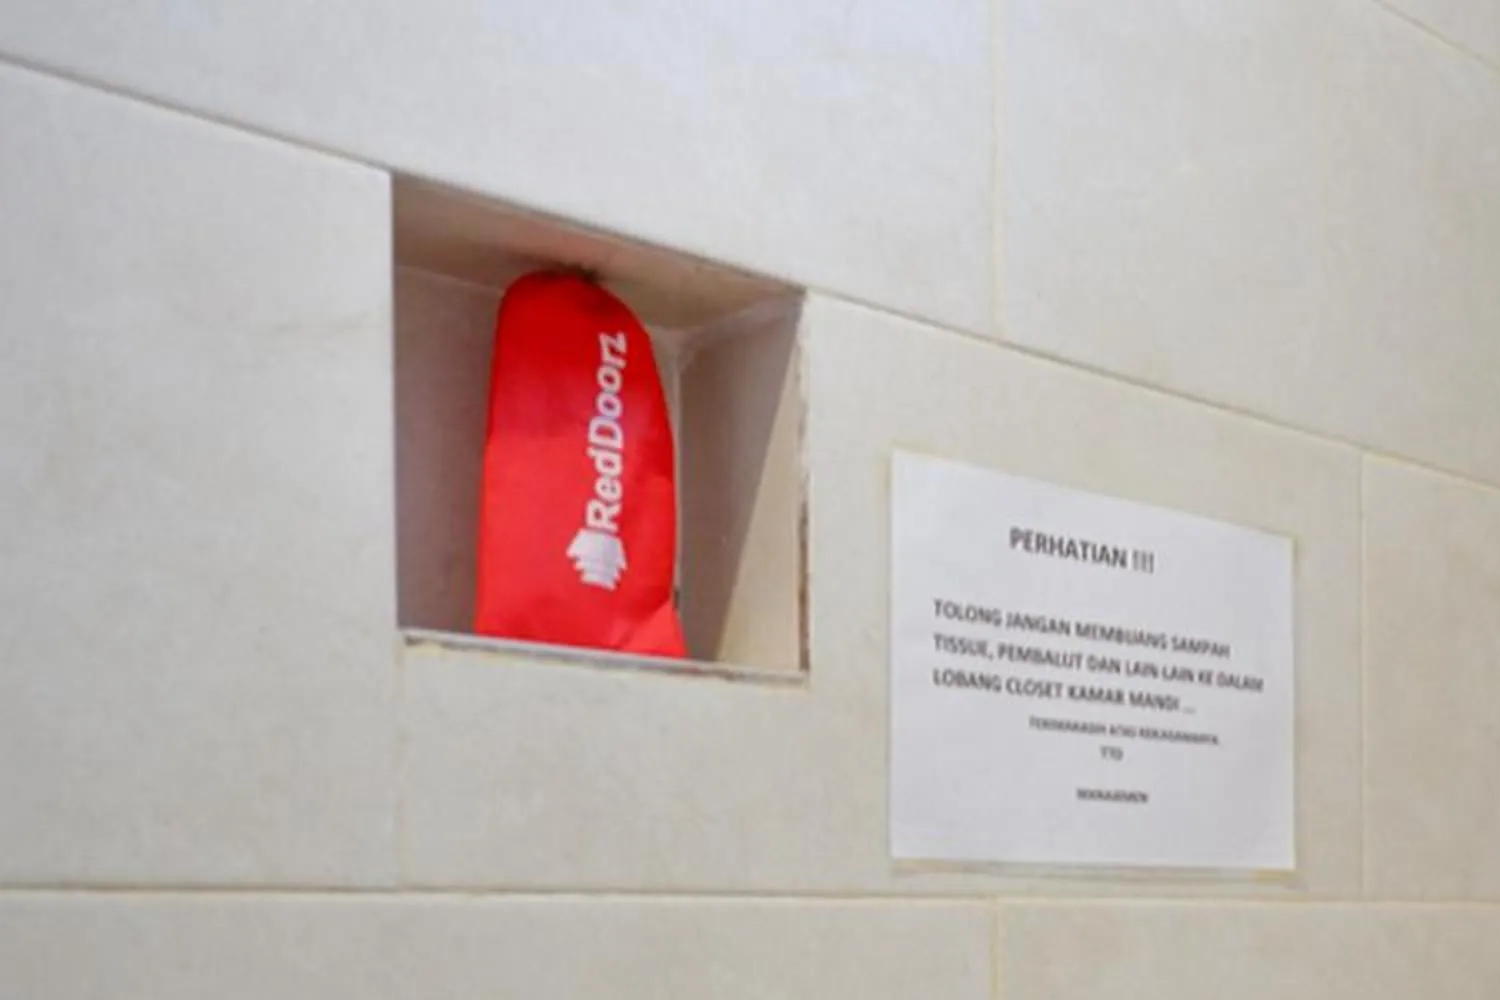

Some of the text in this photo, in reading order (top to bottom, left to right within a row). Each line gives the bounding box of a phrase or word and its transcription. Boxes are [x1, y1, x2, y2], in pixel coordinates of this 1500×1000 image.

[586, 331, 627, 532] RedDoorz
[1009, 526, 1127, 569] PERHATIAN
[933, 598, 1231, 659] TOLONG JANGAN MEMBUANG SAMPAH
[932, 668, 1002, 693] LOBANG
[1005, 677, 1063, 699] CLOSET
[1067, 684, 1126, 705] KAMAR
[1129, 690, 1180, 712] MANDI
[933, 633, 1264, 693] TISSUE, PEMBALUT DAN LAIN LAIN KE DALAM
